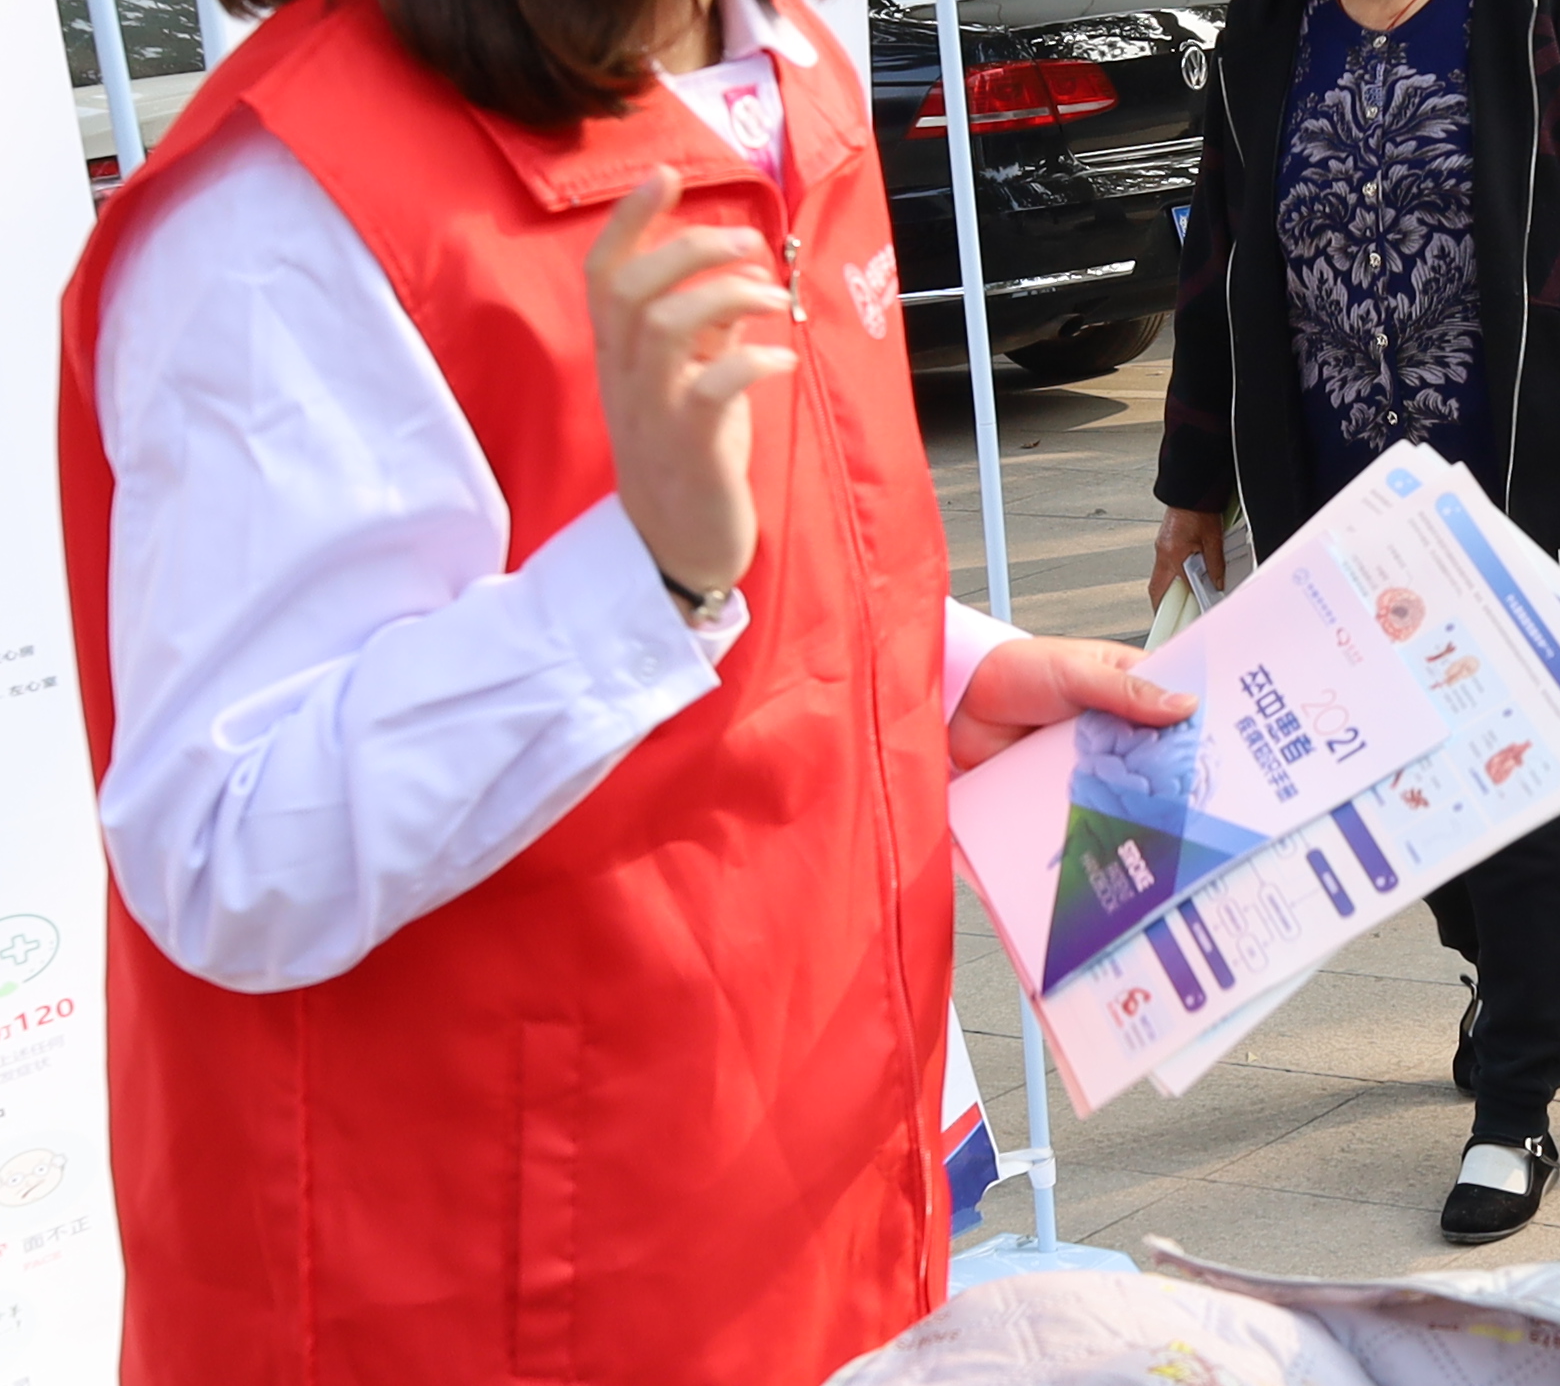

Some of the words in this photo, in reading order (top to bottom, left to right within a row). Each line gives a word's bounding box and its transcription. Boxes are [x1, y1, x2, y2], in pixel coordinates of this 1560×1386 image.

[1232, 661, 1319, 769] 卒中患者
[1297, 683, 1371, 767] 2021
[21, 1214, 93, 1256] 面不正
